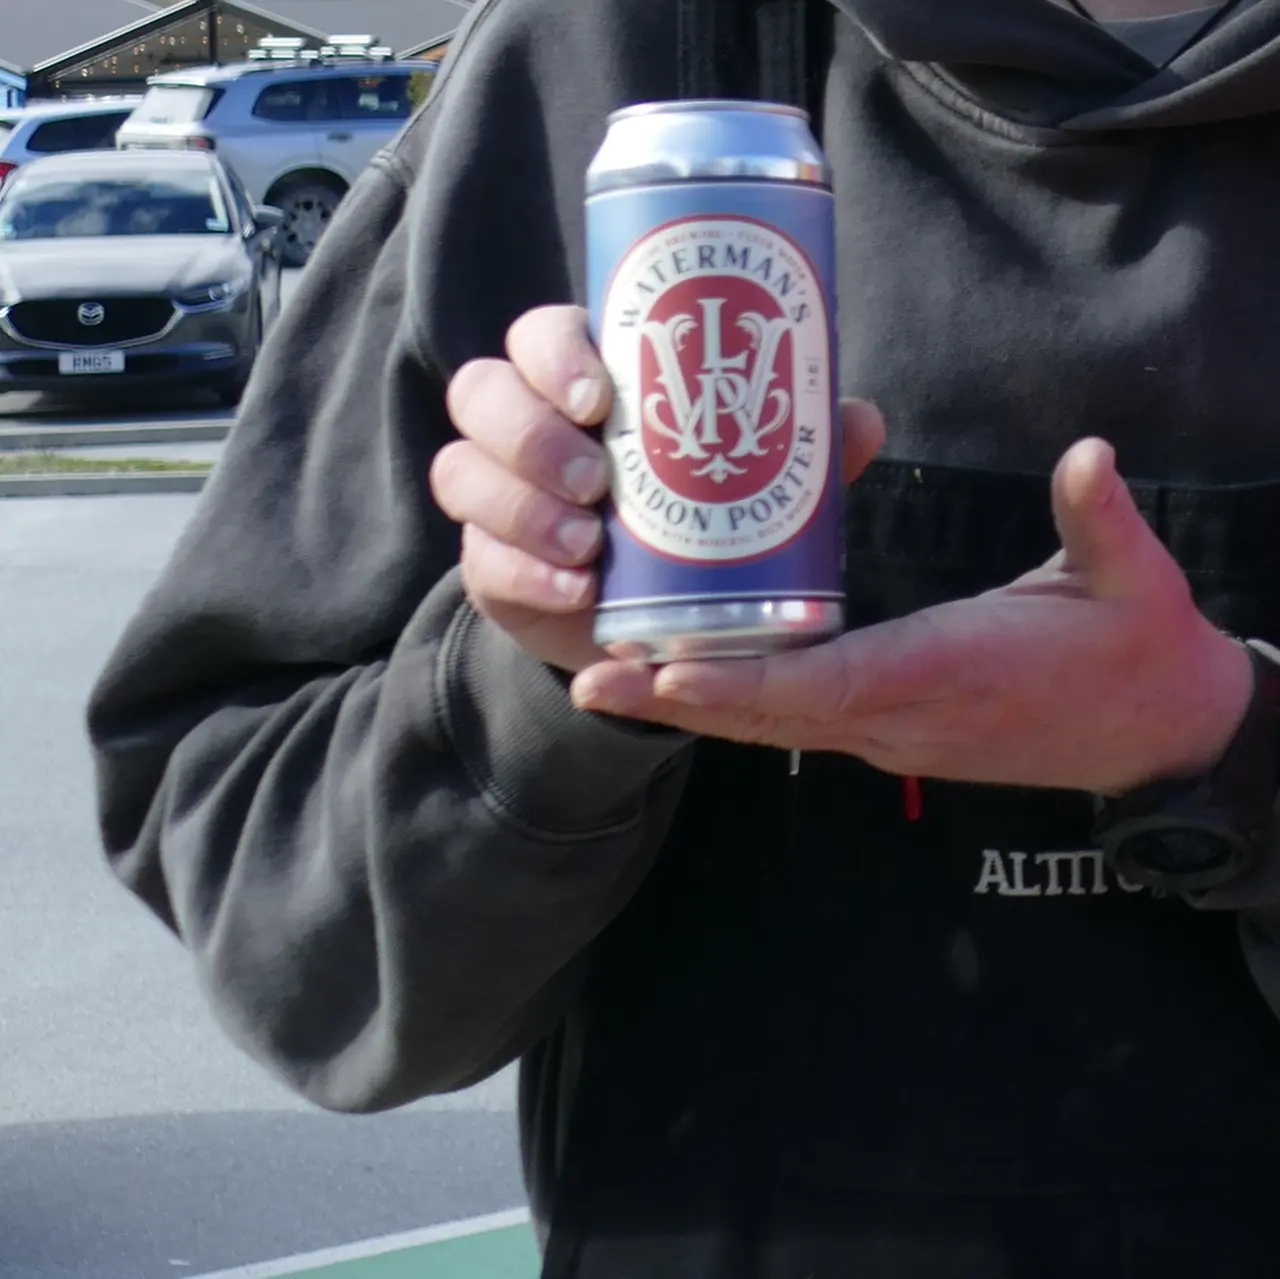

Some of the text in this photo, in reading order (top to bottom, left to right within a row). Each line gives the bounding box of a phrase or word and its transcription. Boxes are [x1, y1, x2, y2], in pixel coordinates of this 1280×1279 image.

[618, 243, 812, 328] WATERMAN'S
[618, 427, 713, 533] LONDON
[729, 423, 818, 532] PORTER
